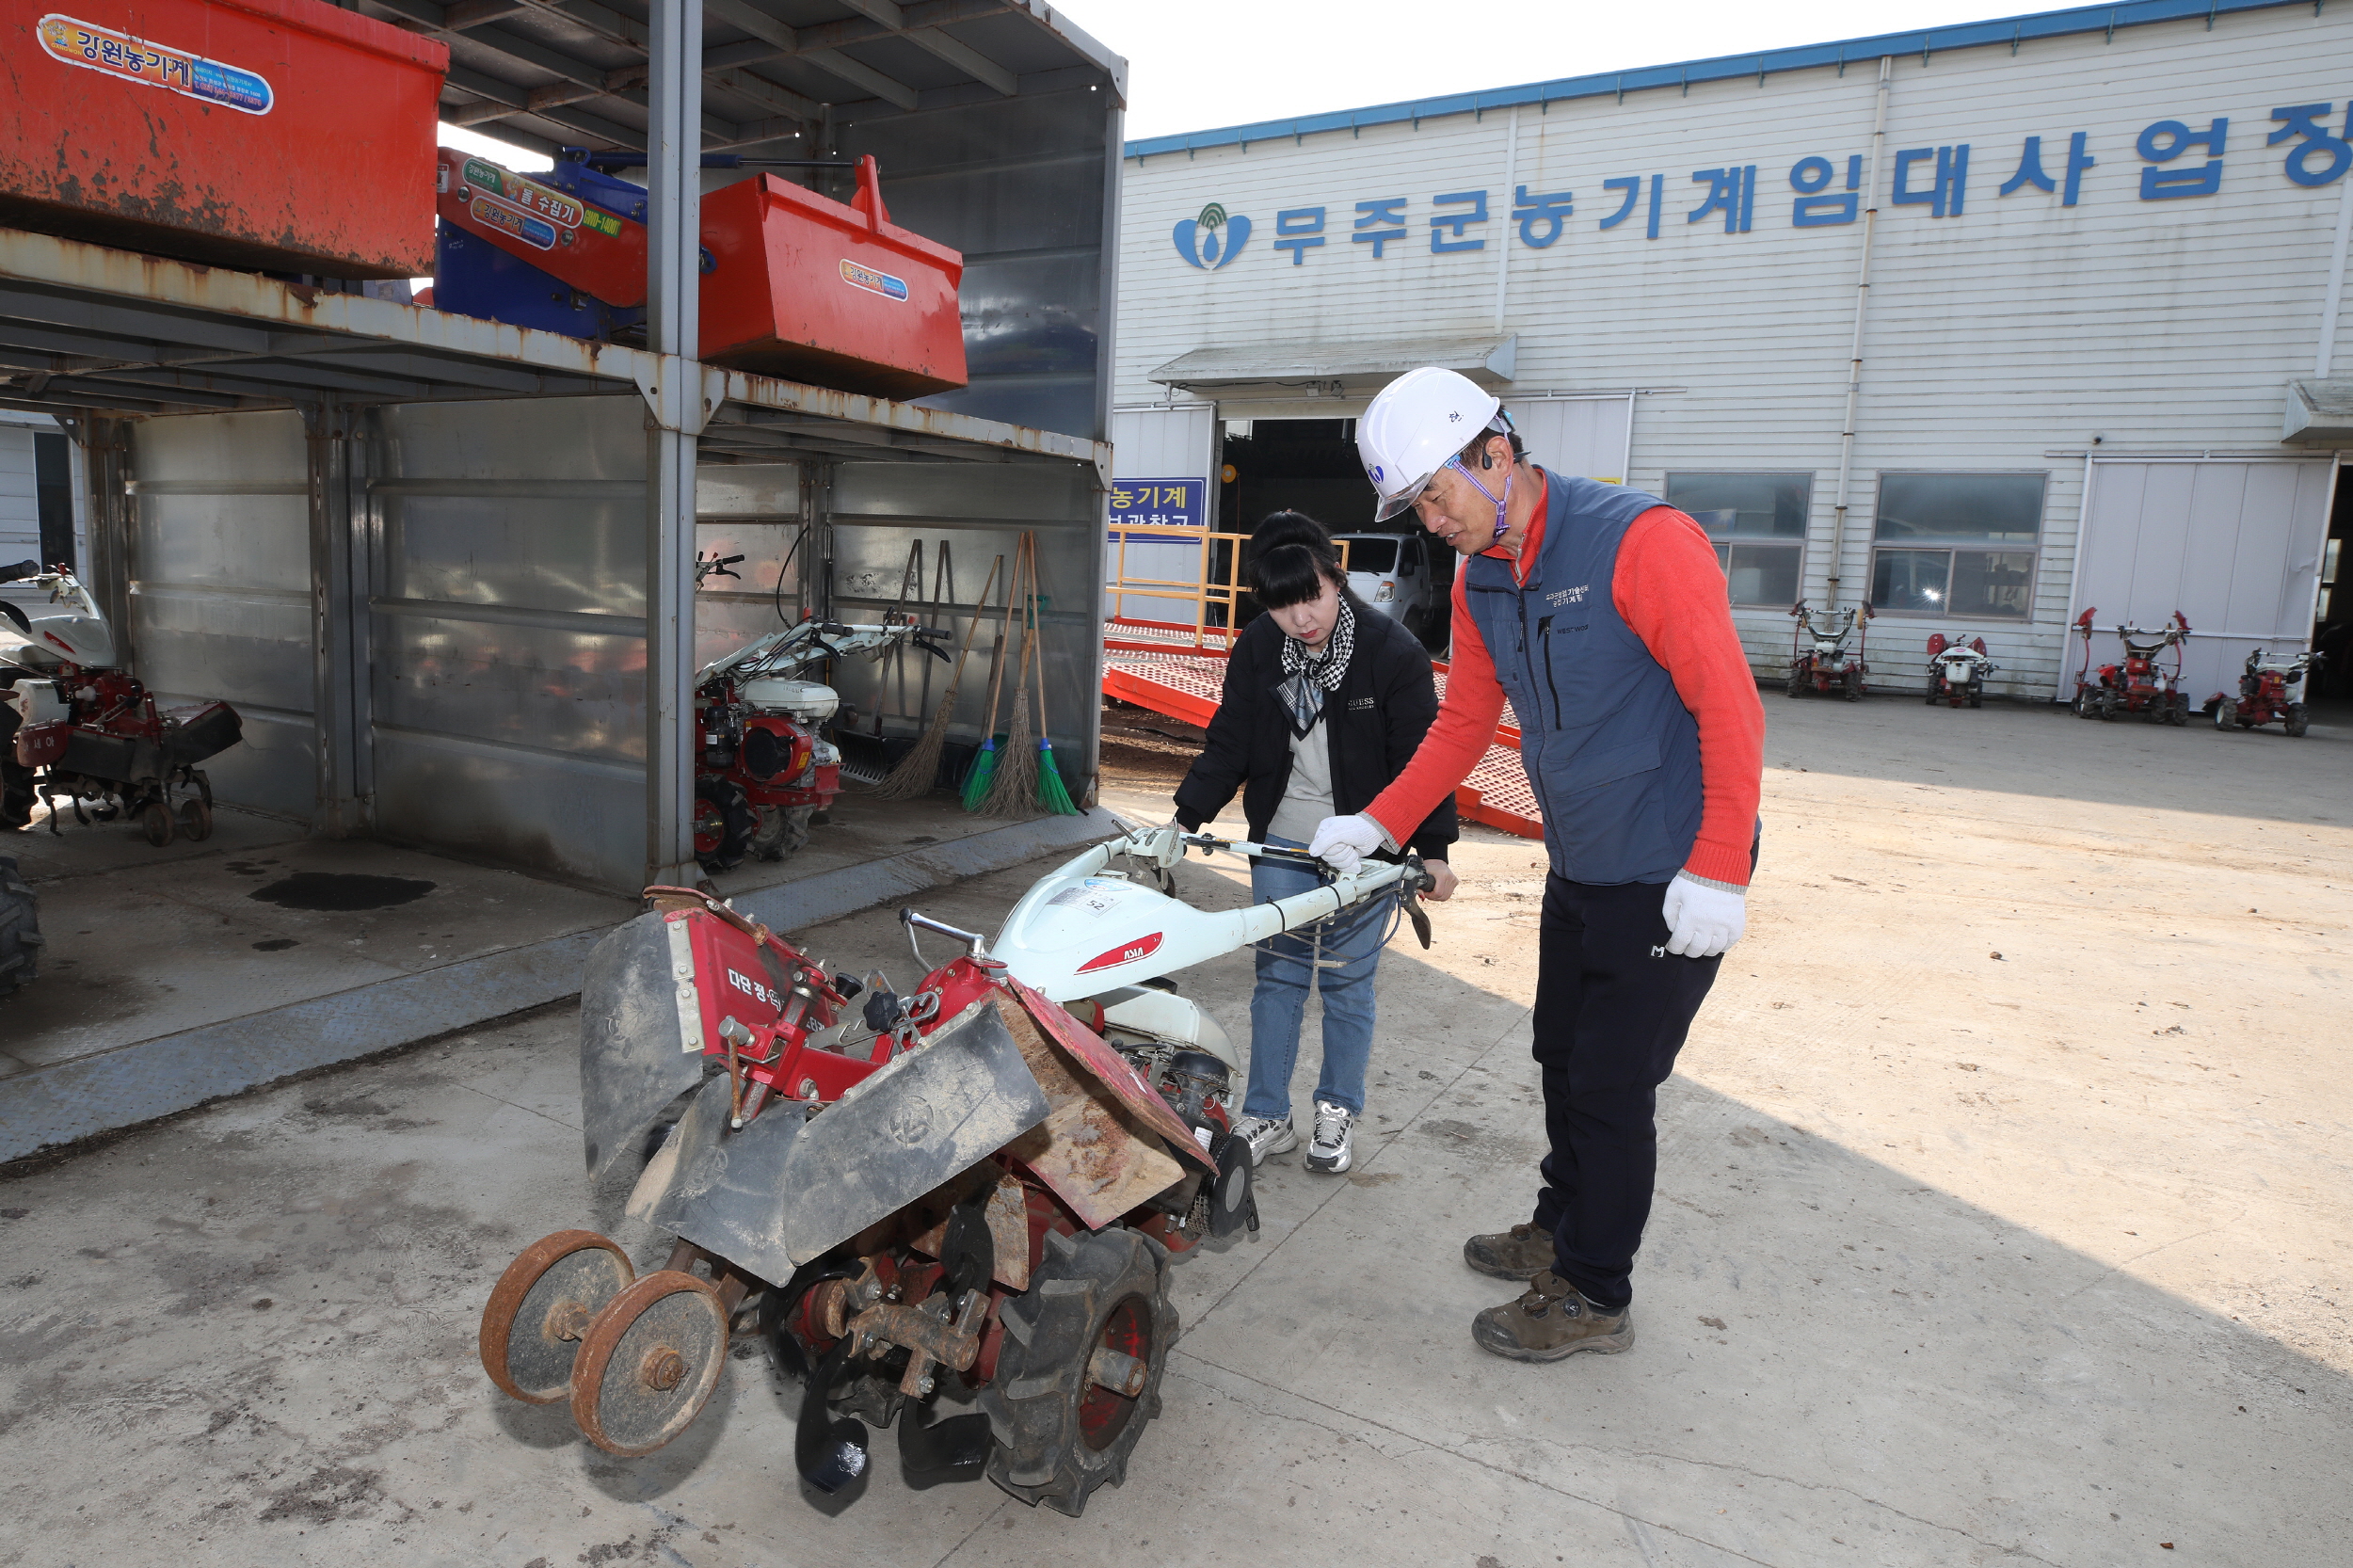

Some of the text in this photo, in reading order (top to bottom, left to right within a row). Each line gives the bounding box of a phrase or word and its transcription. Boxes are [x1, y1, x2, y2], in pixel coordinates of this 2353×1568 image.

[51, 42, 83, 56] GANGWON
[77, 30, 191, 88] 강원농기계
[469, 164, 496, 184] 강원농기계
[484, 203, 523, 233] 강원농기계
[538, 195, 575, 223] 수집기
[850, 266, 884, 290] 강원농기계
[1111, 486, 1186, 509] 농기계
[1086, 899, 1105, 911] 52
[1124, 947, 1144, 960] ASIA
[728, 968, 753, 996] 다단
